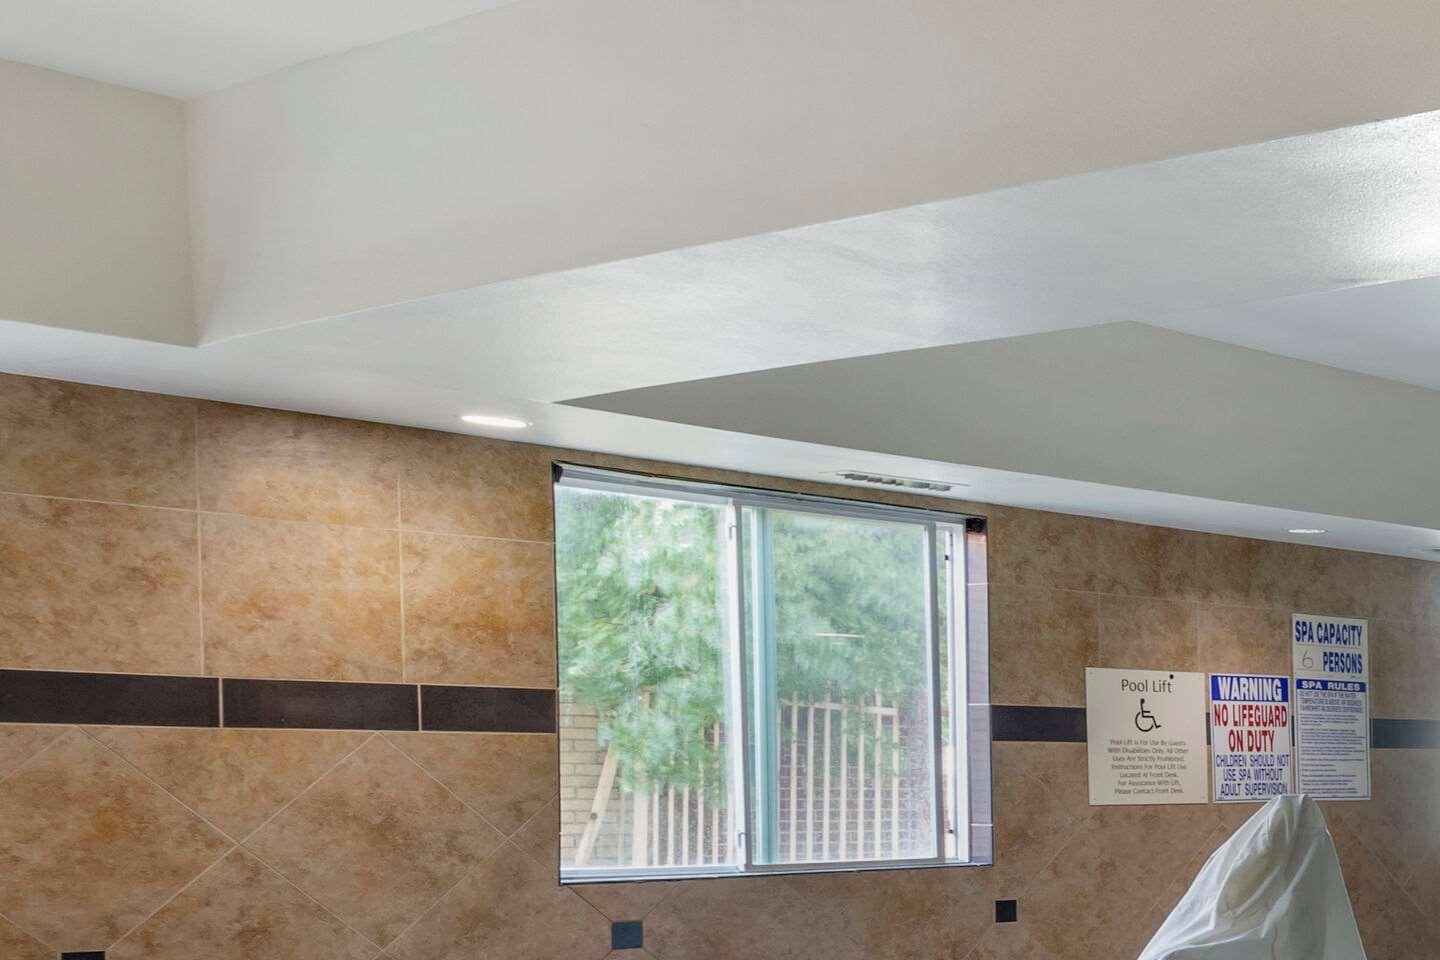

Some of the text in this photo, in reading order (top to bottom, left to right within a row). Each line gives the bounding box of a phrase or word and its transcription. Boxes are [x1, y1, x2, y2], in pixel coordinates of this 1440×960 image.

[1295, 620, 1362, 647] SPA CAPACITY
[1302, 650, 1314, 669] 6
[1322, 651, 1363, 674] PERSONS
[1121, 679, 1173, 693] Pool Lift
[1217, 676, 1283, 702] WARNING
[1302, 680, 1361, 692] SPA RULES
[1214, 704, 1229, 727] NO
[1232, 705, 1287, 727] LIFEGUARD
[1228, 729, 1244, 752] ON
[1247, 730, 1275, 752] DUTY
[1215, 754, 1290, 768] CHILDREN SHOULD NOT
[1223, 768, 1284, 781] USE SPA WITHOUT
[1220, 783, 1241, 797] ADULT
[1244, 783, 1288, 796] SUPERVISION
